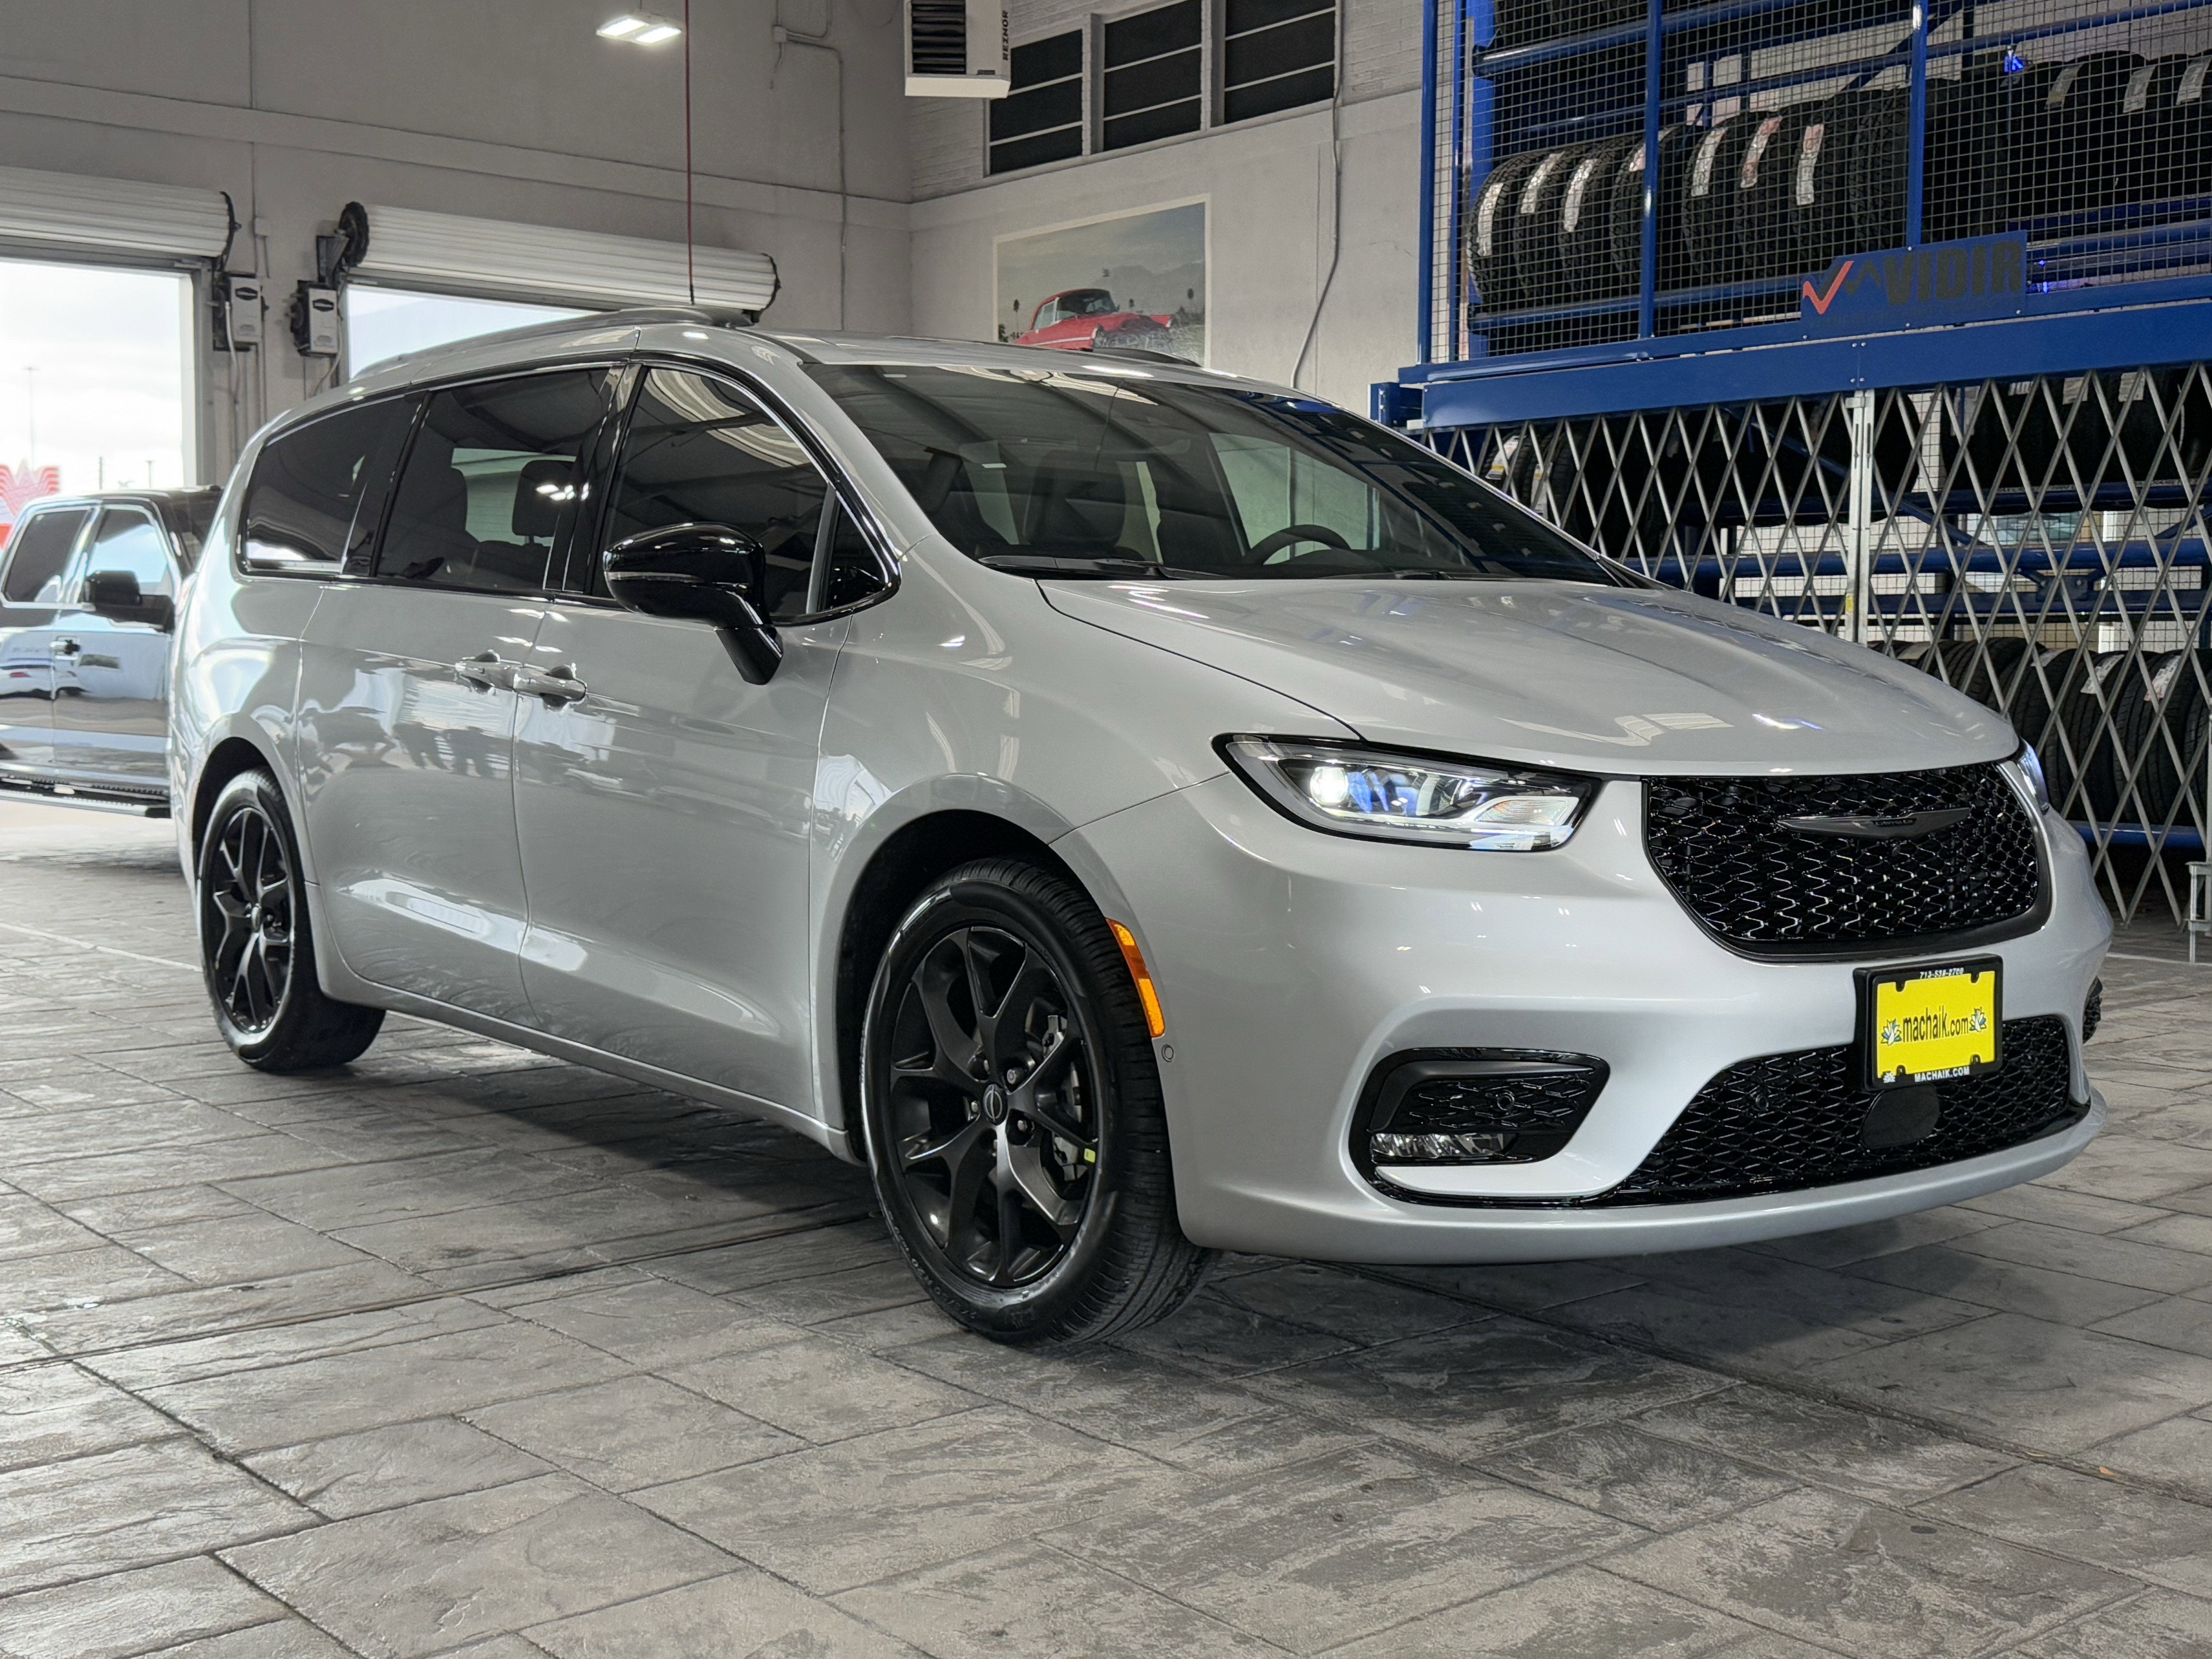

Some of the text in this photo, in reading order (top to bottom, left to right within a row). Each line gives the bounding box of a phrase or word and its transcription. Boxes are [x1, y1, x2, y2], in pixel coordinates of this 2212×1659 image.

[1884, 242, 2022, 306] VIDIR
[1903, 1005, 1969, 1042] machaik.com
[1915, 1066, 1970, 1082] MACHAIK.COM
